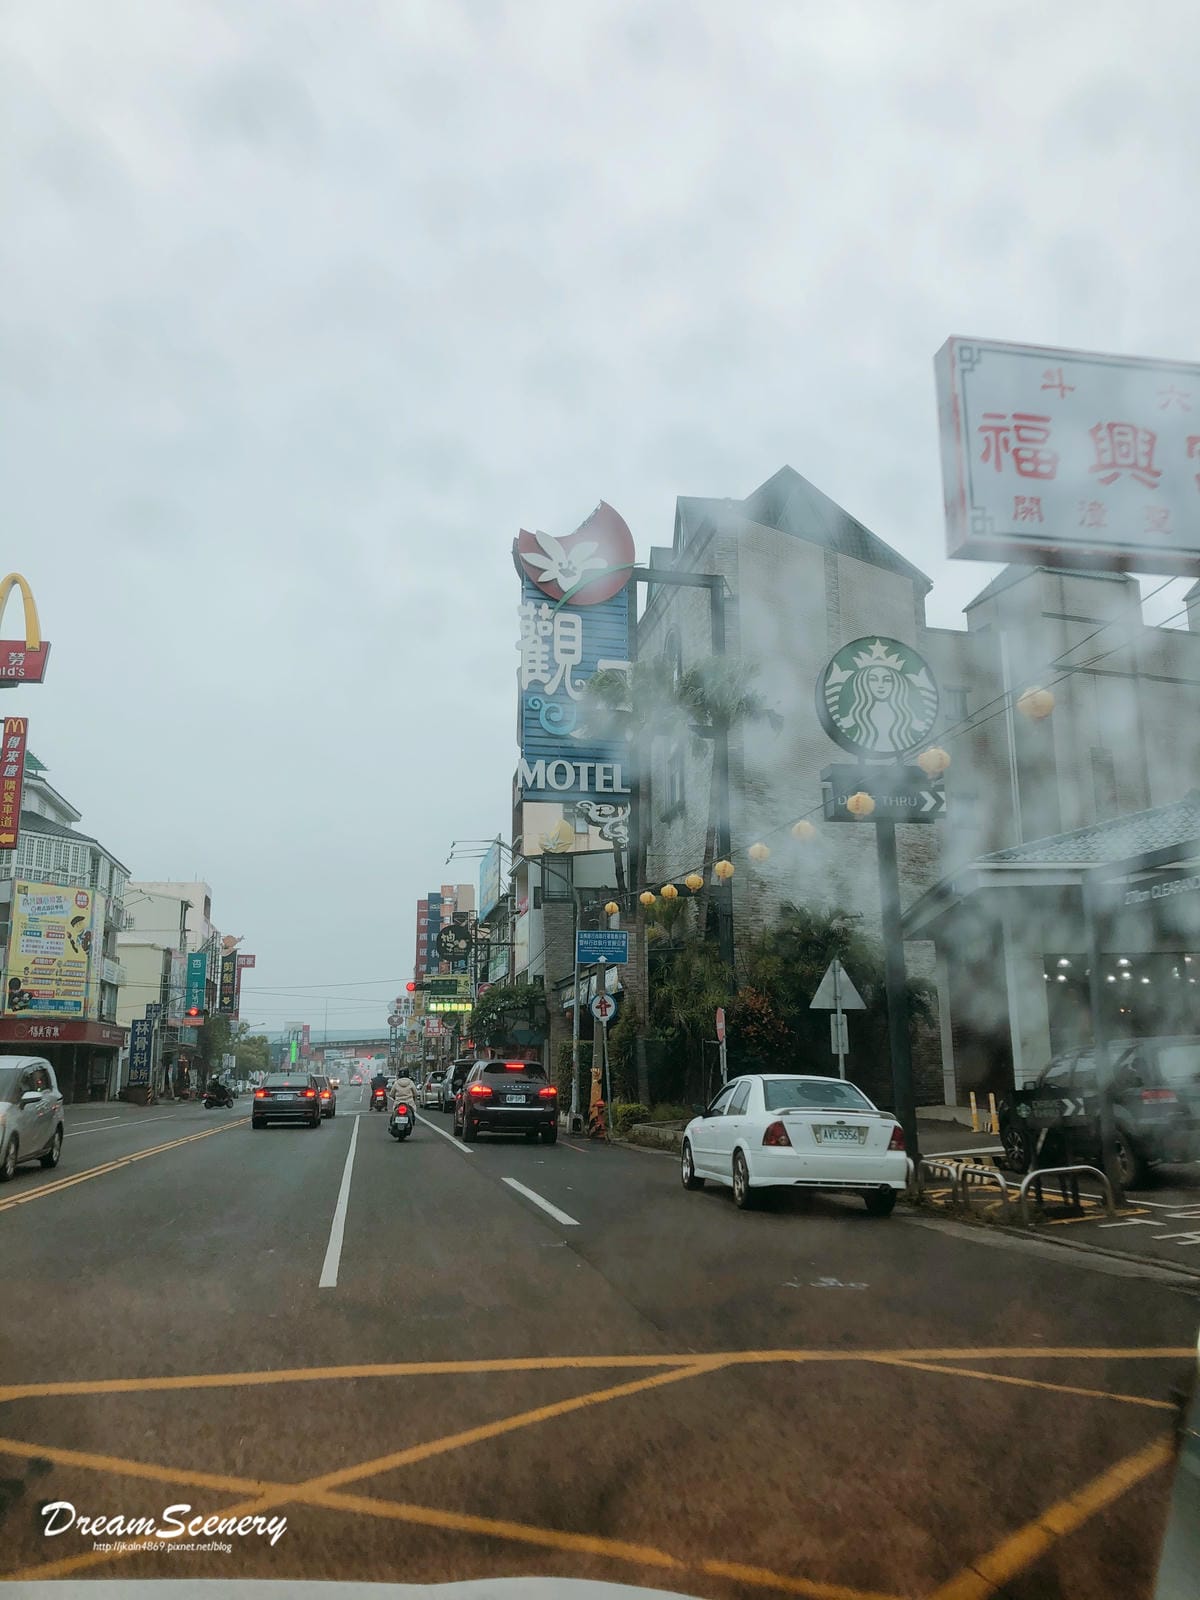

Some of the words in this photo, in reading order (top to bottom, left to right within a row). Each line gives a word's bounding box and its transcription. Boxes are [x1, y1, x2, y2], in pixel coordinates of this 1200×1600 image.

[977, 412, 1200, 495] 福興
[0, 666, 25, 677] ld's
[3, 736, 20, 777] 得來速
[516, 757, 632, 793] MOTEL
